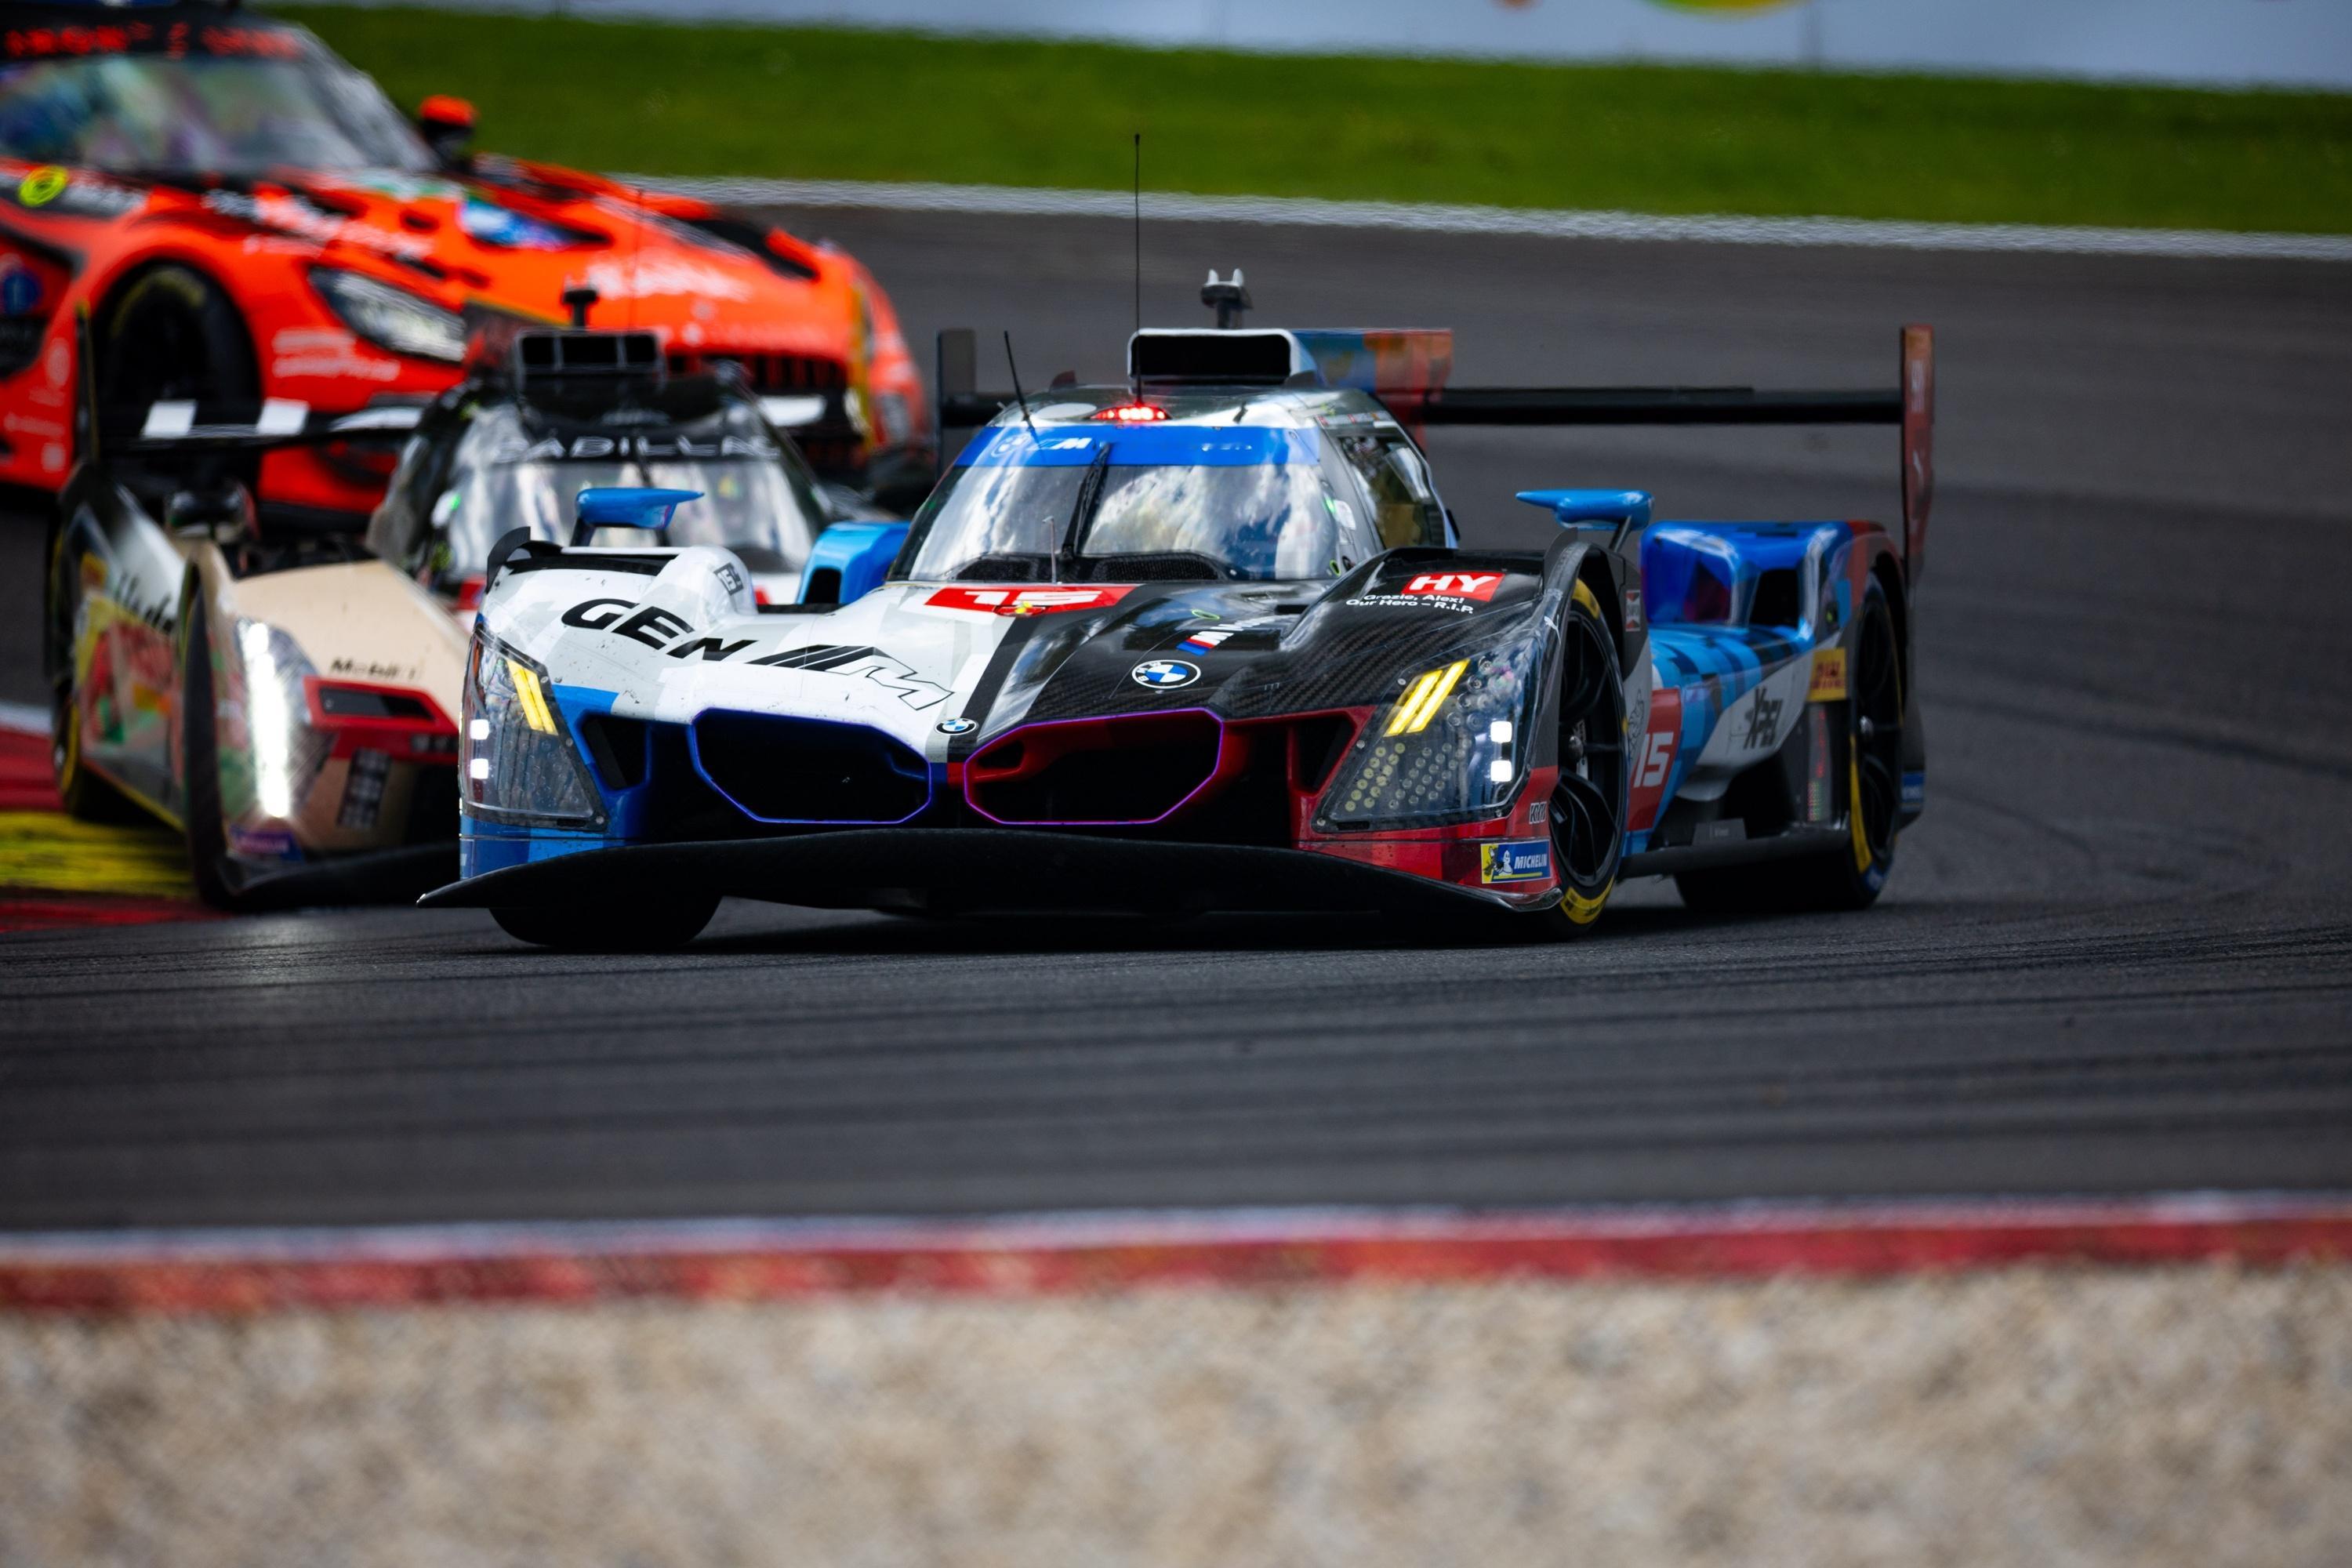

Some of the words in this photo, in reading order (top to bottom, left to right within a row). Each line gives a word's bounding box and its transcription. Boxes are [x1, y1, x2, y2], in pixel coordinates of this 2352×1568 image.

[1409, 575, 1497, 593] HY
[964, 590, 1103, 606] 15
[1422, 594, 1465, 604] Alex!
[1434, 601, 1474, 614] R.I.P.
[561, 598, 759, 661] GEN
[1633, 731, 1675, 789] 15
[1514, 853, 1548, 869] MICHELIN
